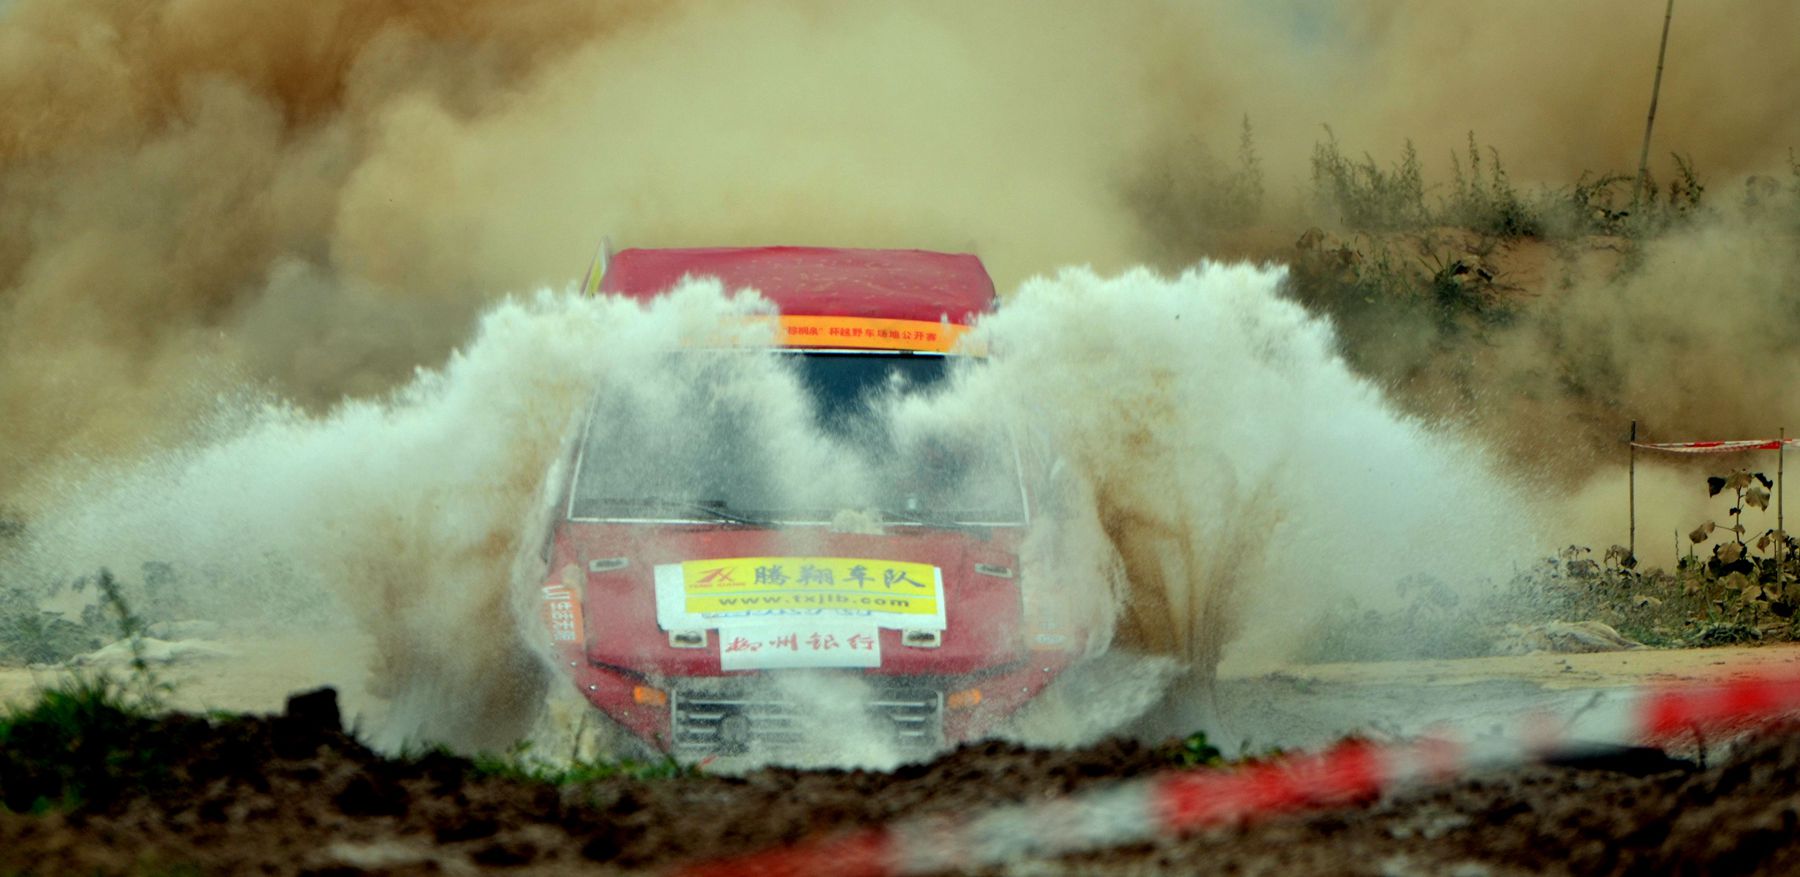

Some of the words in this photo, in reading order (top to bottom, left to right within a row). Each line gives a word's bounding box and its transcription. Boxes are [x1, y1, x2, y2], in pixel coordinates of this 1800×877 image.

[754, 564, 926, 588] 腾翔车队
[725, 632, 875, 653] 柳州银行
